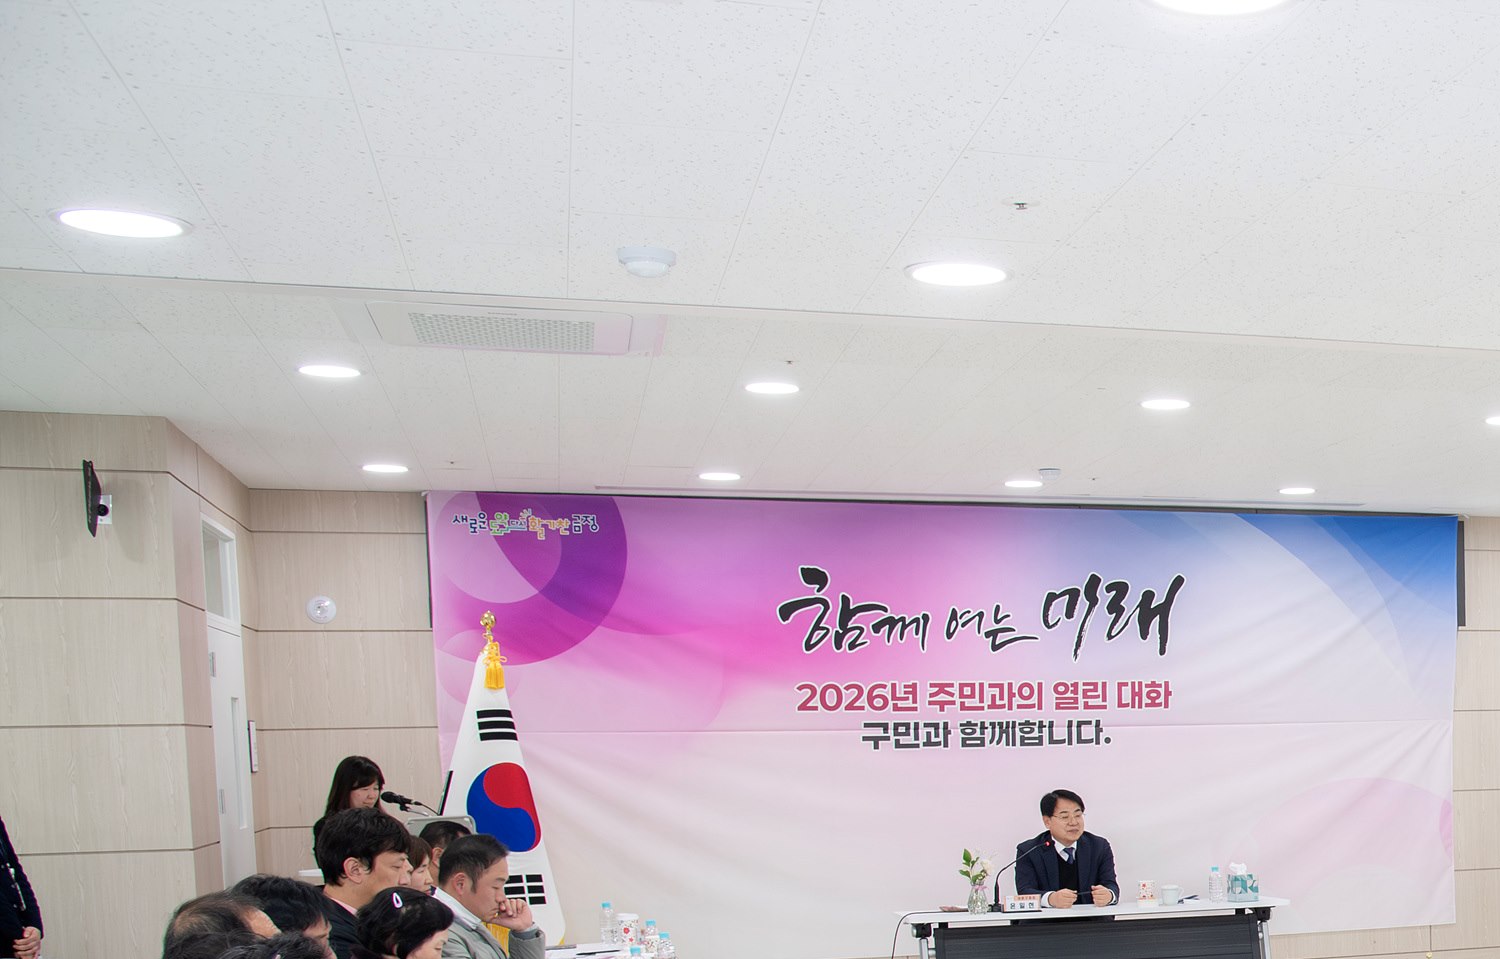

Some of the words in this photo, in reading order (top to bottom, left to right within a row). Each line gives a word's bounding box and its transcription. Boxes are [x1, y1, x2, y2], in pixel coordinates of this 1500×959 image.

[452, 512, 487, 534] 새로운
[528, 515, 570, 540] 활기찬
[572, 513, 600, 534] 금정
[778, 566, 931, 653] 함께
[944, 603, 1040, 654] 여는
[1041, 572, 1185, 662] 미래
[795, 681, 919, 713] 2026년
[927, 680, 1044, 712] 주민과의
[1053, 680, 1108, 711] 열린
[1116, 680, 1172, 710] 대화
[862, 721, 951, 750] 구민과
[960, 719, 1112, 748] 함께합니다.
